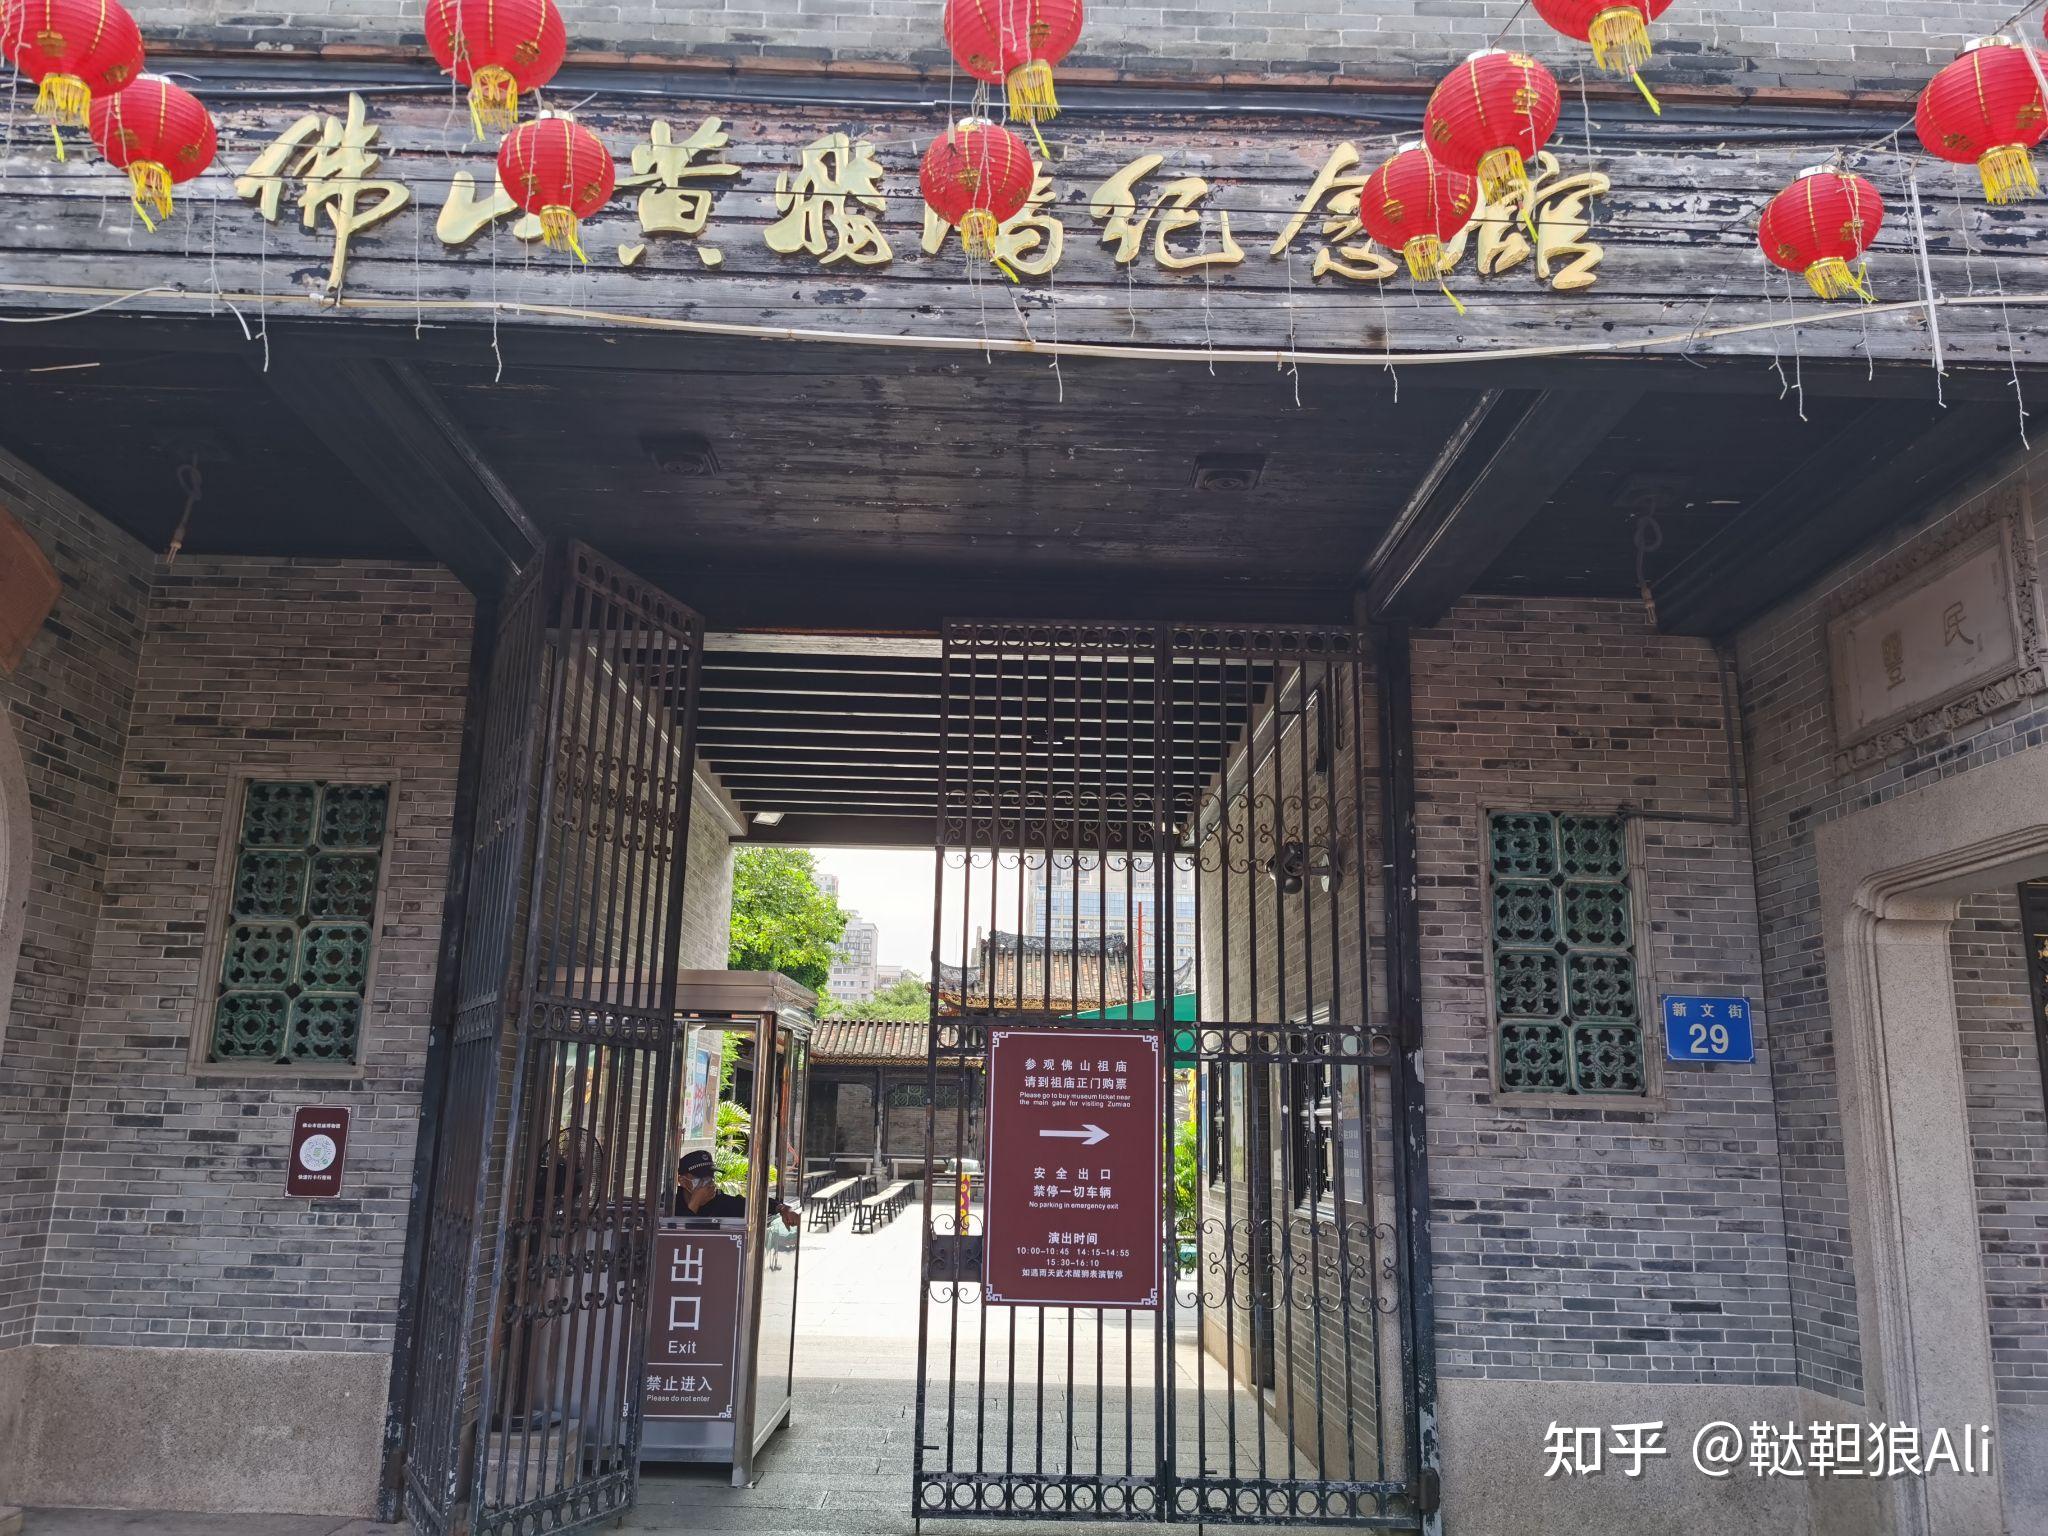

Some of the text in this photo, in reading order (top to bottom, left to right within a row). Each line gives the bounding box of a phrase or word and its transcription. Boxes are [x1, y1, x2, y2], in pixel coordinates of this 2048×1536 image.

[1672, 1002, 1742, 1019] 新文街
[1689, 1023, 1729, 1054] 29
[1024, 1057, 1128, 1073] 参观佛山祖庙
[1024, 1075, 1127, 1090] 请到祖庙正门购票
[1033, 1166, 1111, 1181] 安全出口
[1033, 1184, 1112, 1199] 禁停一切车辆
[1071, 1203, 1106, 1211] emergency
[1048, 1231, 1098, 1245] 演出时间
[668, 1244, 704, 1331] 出口
[668, 1340, 697, 1354] Exit
[646, 1375, 713, 1392] 禁止进入
[646, 1394, 670, 1402] Please
